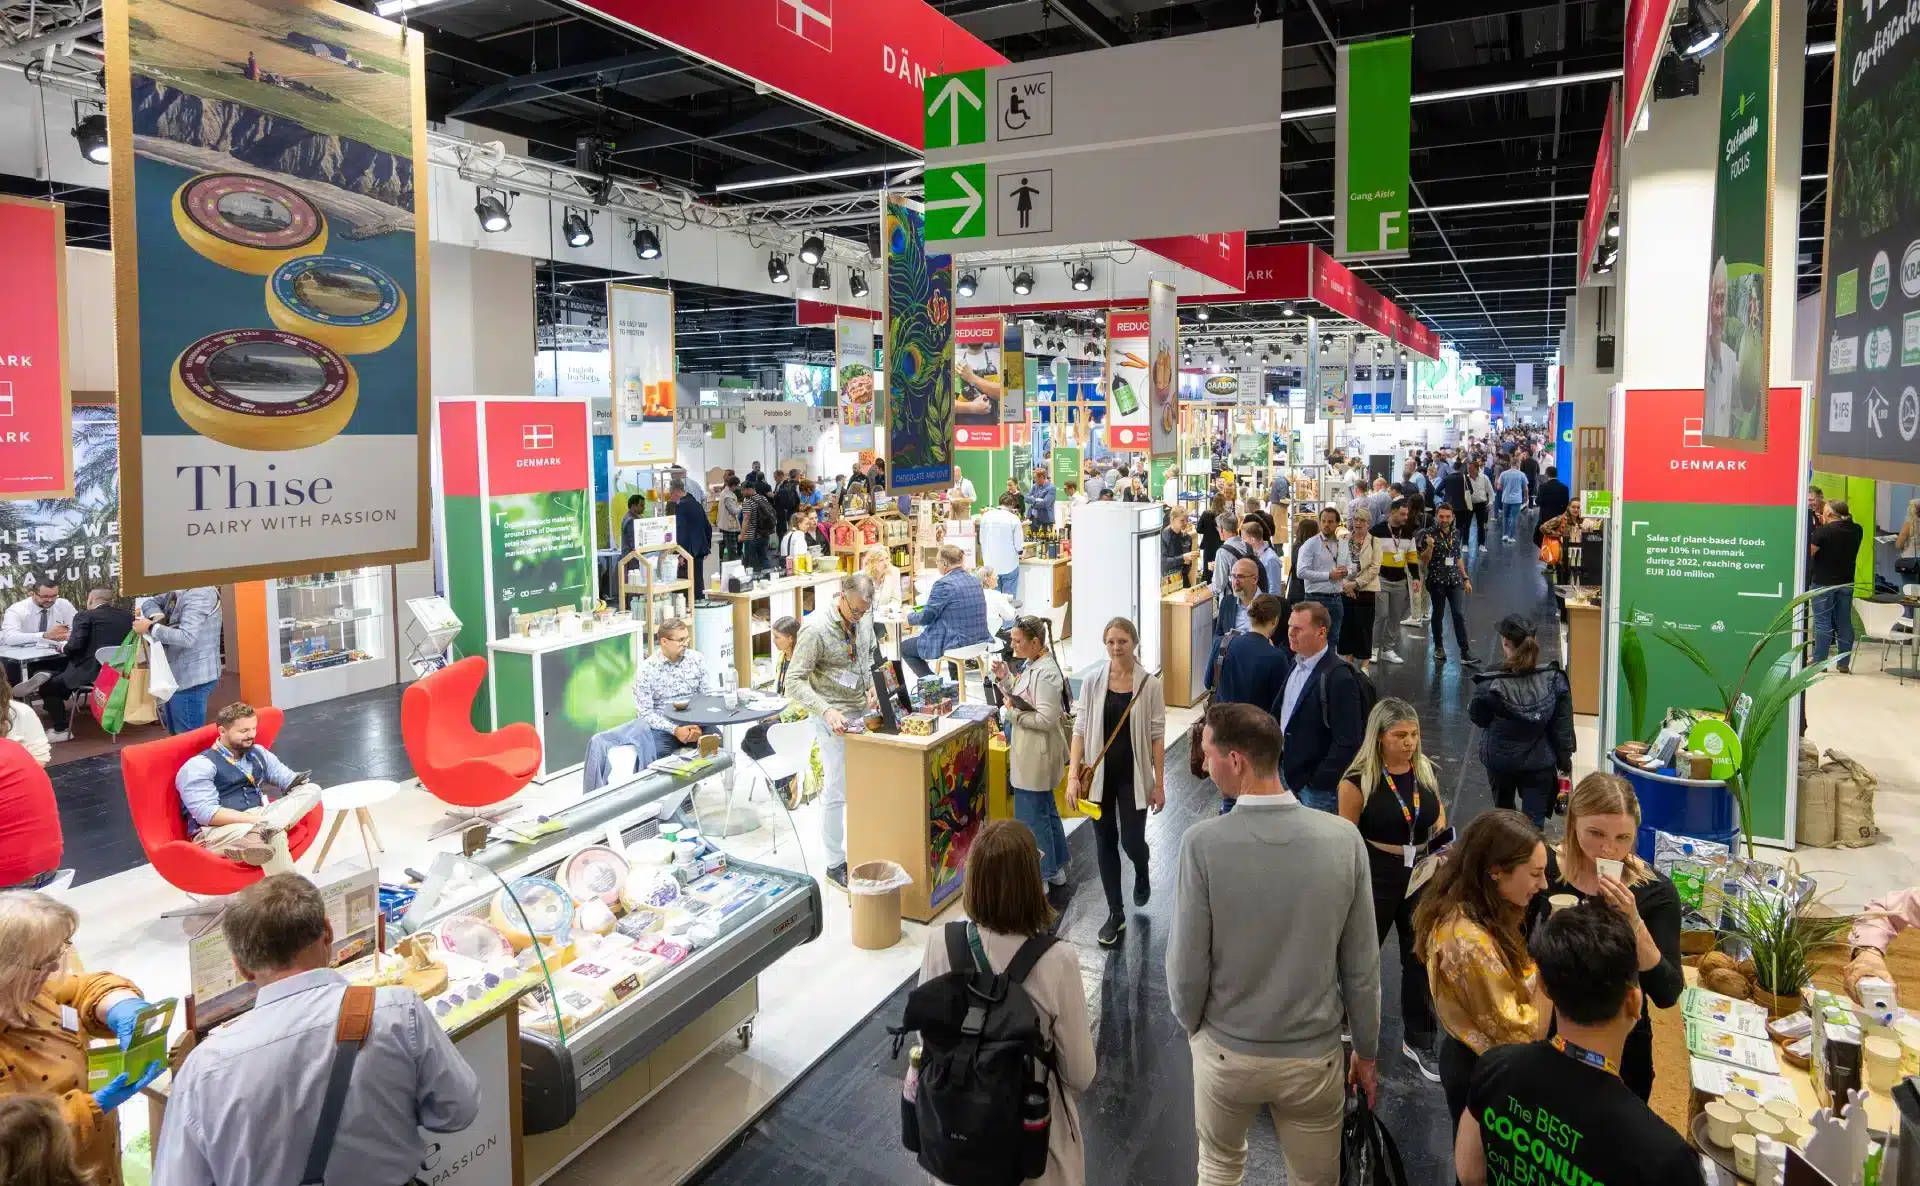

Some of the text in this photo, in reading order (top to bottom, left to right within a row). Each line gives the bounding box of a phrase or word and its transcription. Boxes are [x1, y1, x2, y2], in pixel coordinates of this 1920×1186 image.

[883, 43, 930, 92] DÄN
[1023, 81, 1046, 96] WC
[1730, 151, 1751, 181] FOCUS
[1350, 189, 1396, 202] Gang Aisle
[1378, 210, 1402, 251] F
[1246, 269, 1274, 281] ARK
[955, 329, 994, 338] REDUCED
[1117, 322, 1149, 332] REDUC
[1207, 380, 1238, 390] DAABON
[1038, 390, 1055, 402] AY
[515, 457, 562, 468] DENMARK
[1669, 459, 1748, 470] DENMARK
[895, 470, 925, 483] CHOCOLATE
[176, 463, 333, 512] Thise
[1587, 490, 1599, 498] 5.1
[1590, 506, 1611, 515] F79
[83, 521, 119, 537] WE
[187, 509, 396, 537] DAIRY WITH PASSION
[504, 531, 525, 539] around
[1646, 534, 1766, 547] Sales of plant-based foods
[0, 542, 120, 567] RESPECT
[1646, 546, 1745, 557] grew 10% in Denmark
[1646, 557, 1765, 570] during 2022, reaching over
[0, 564, 121, 589] NATURE
[1646, 567, 1715, 578] EUR 100 million
[1507, 1094, 1584, 1154] The BEST
[432, 1134, 498, 1186] PASSION
